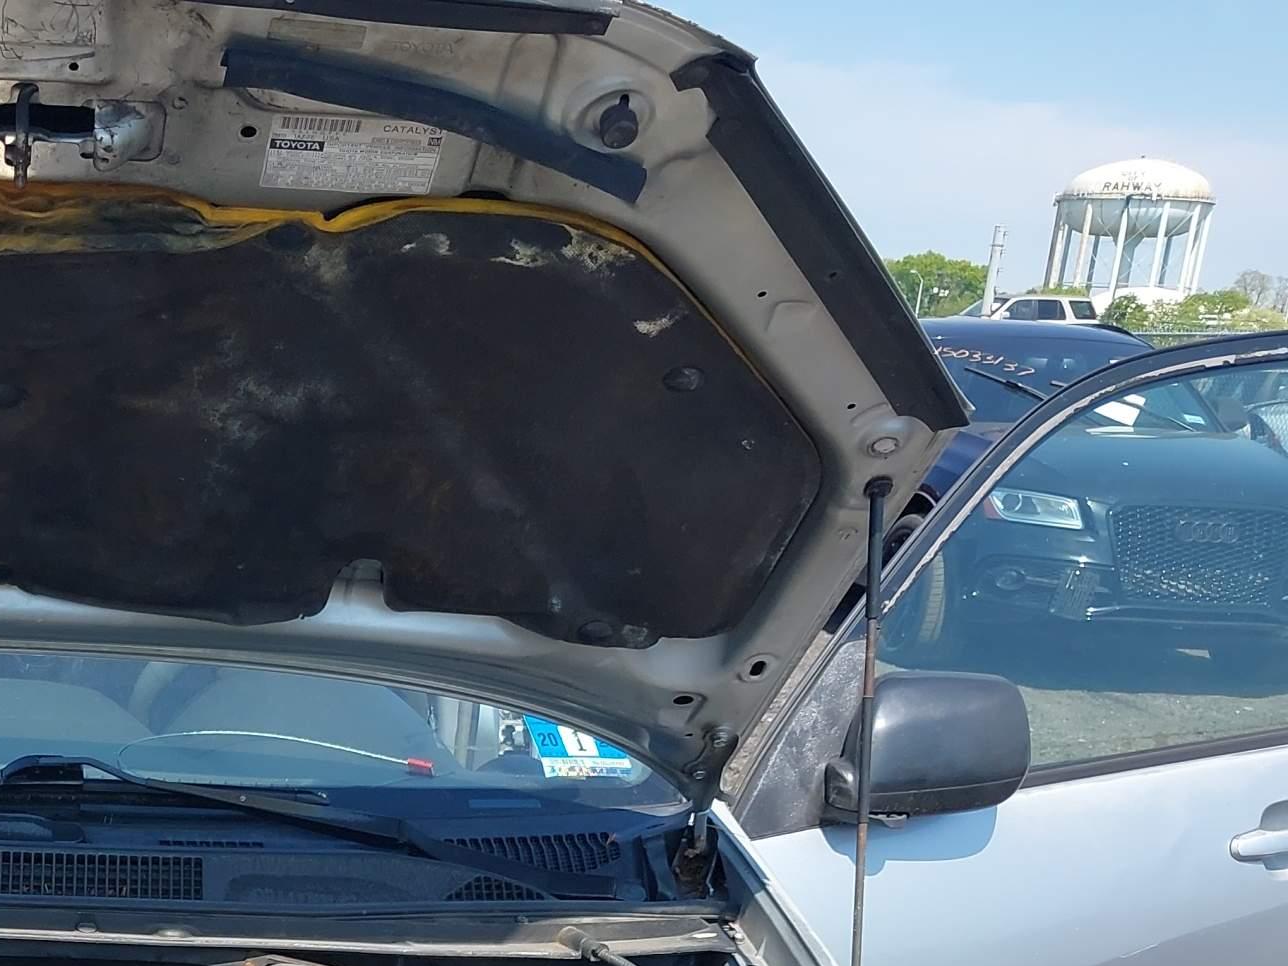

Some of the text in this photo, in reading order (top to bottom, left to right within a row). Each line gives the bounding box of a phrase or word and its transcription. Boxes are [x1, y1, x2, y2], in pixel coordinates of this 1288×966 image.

[274, 140, 320, 150] TOYOTA
[1103, 181, 1162, 191] RAHWAY
[537, 732, 559, 747] 20
